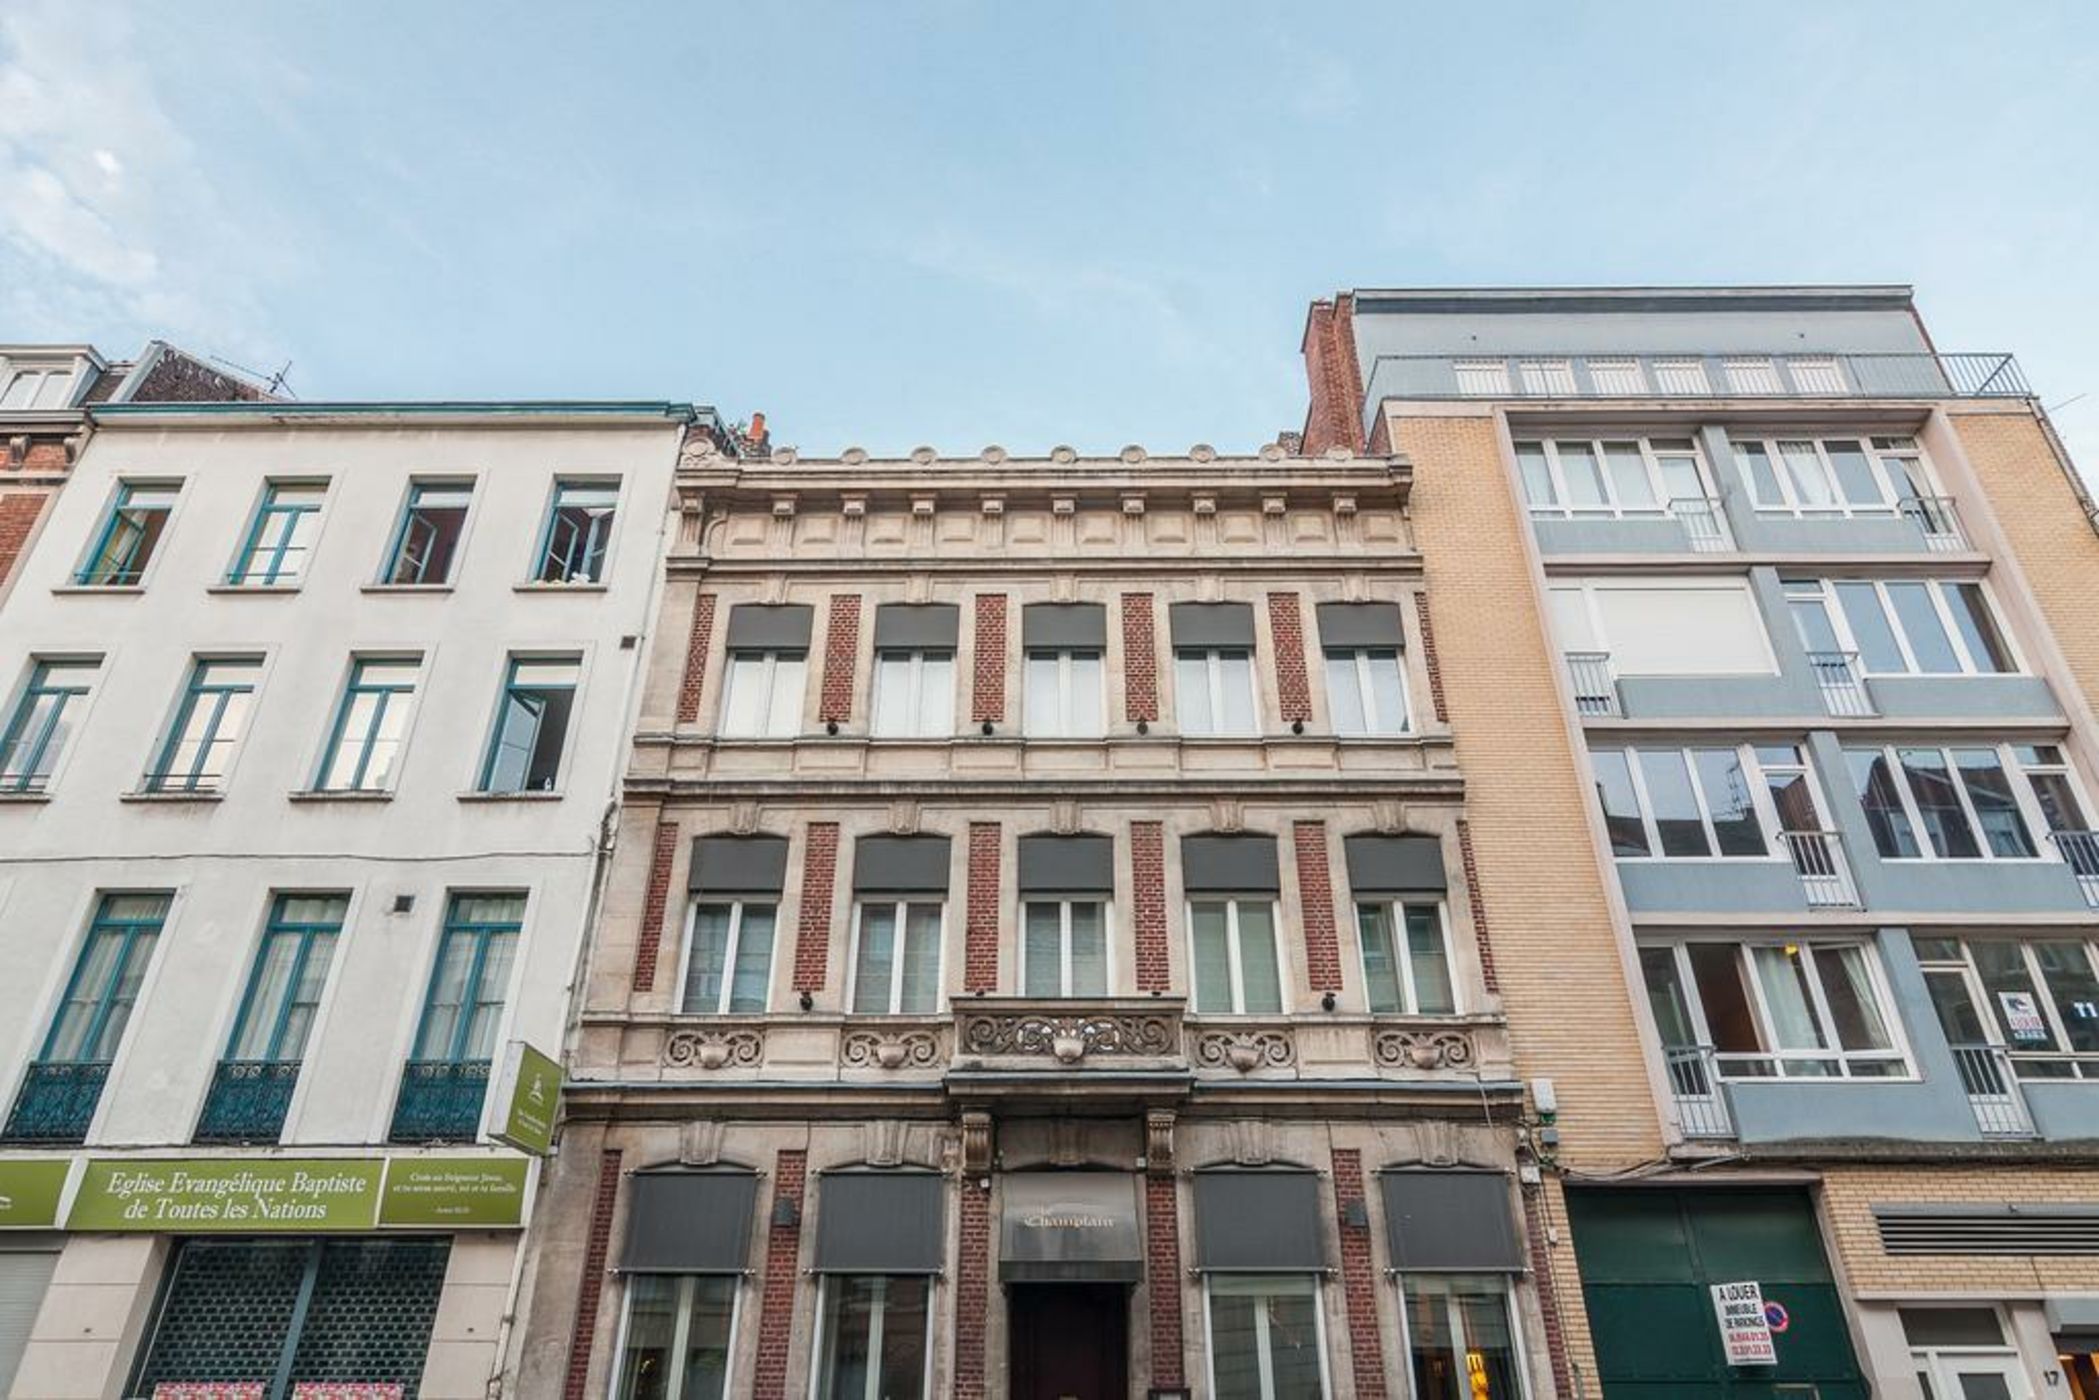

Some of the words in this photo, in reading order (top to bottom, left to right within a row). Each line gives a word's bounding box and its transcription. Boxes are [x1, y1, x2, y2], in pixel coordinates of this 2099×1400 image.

[106, 1172, 165, 1199] Eglise
[169, 1172, 286, 1199] Evangélique
[291, 1171, 367, 1198] Baptiste
[124, 1199, 149, 1219] de
[156, 1198, 220, 1219] Toutes
[222, 1199, 249, 1219] les
[251, 1198, 327, 1219] Nations
[1726, 1284, 1760, 1301] LOUER
[2043, 1370, 2059, 1386] 17
